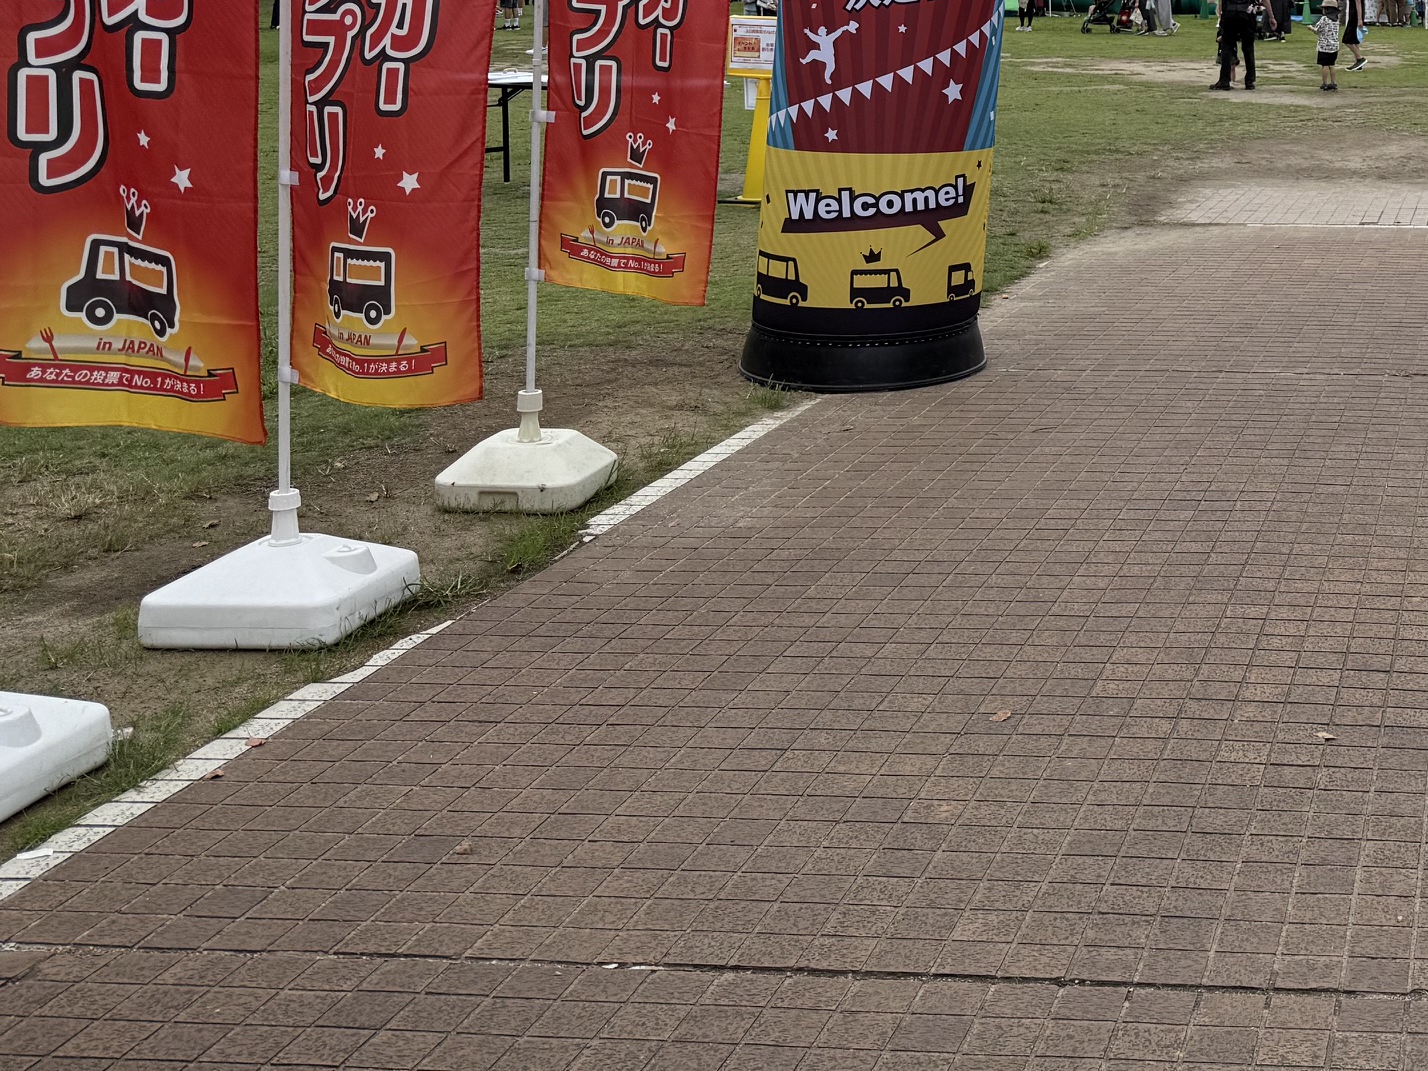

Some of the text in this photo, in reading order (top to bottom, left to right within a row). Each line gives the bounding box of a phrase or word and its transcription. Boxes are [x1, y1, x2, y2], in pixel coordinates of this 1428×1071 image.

[787, 176, 965, 220] Welcome!
[605, 236, 645, 249] in JAPAN
[337, 329, 372, 346] in JAPAN
[96, 337, 164, 359] in JAPAN
